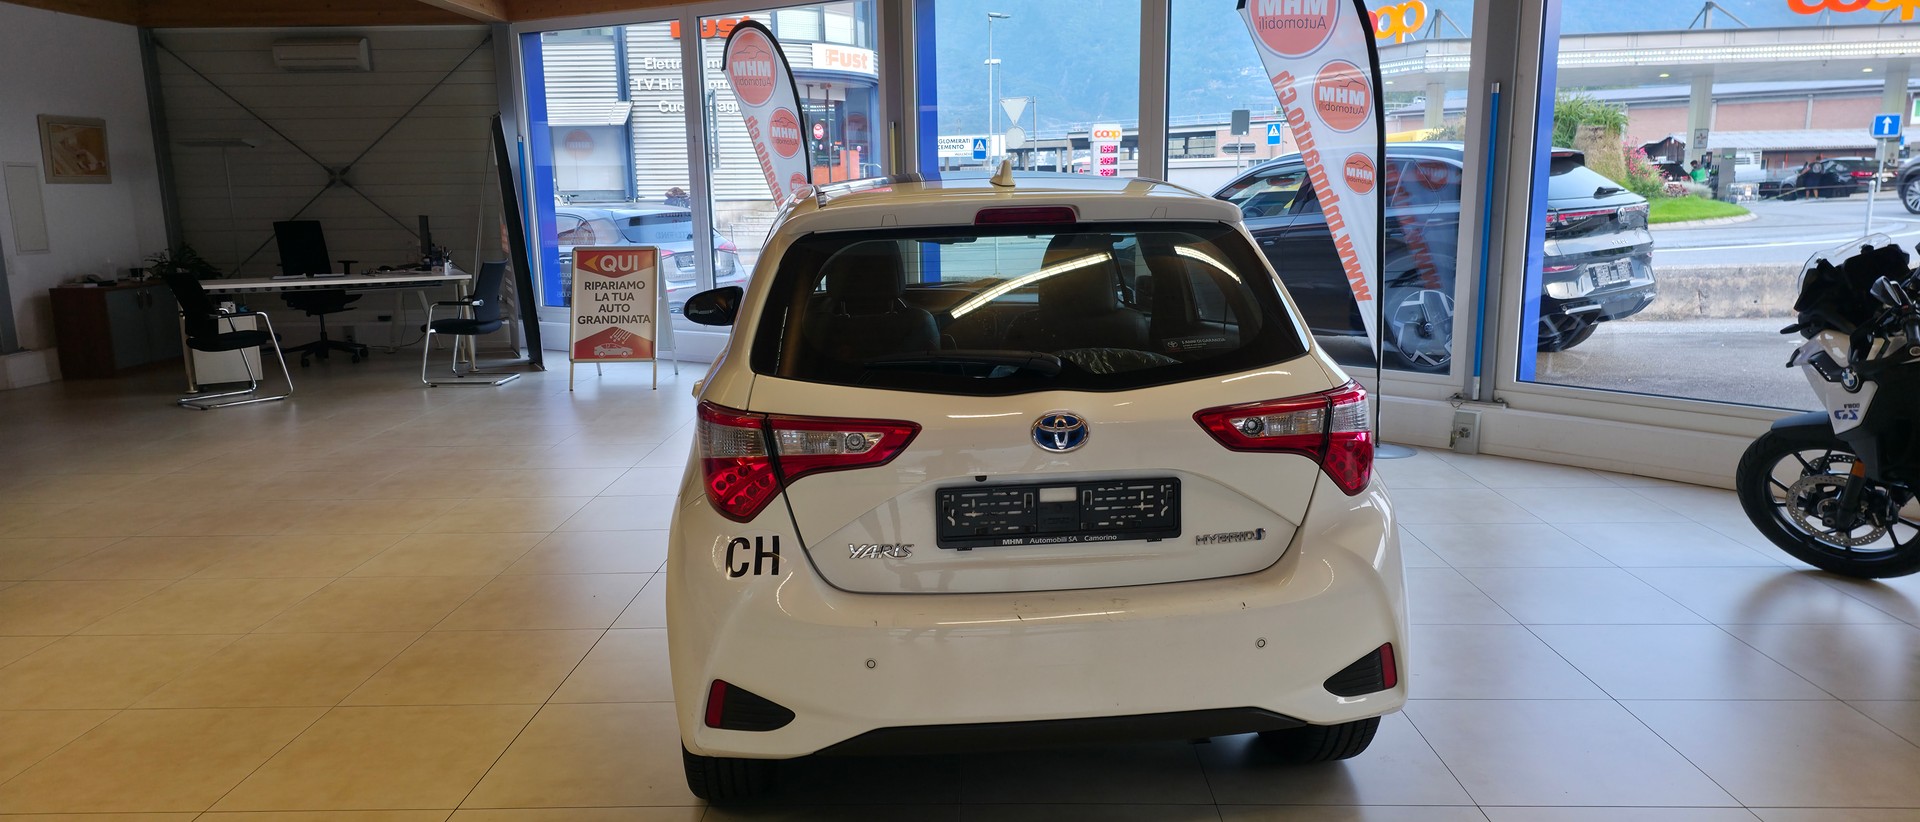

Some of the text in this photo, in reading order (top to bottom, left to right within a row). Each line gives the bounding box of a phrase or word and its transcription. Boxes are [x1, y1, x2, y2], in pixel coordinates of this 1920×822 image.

[1368, 0, 1427, 43] op
[828, 48, 868, 70] Fust
[634, 79, 654, 90] TV
[1094, 130, 1121, 140] coop
[600, 255, 638, 272] QUI
[584, 280, 645, 291] RIPARIAMO
[595, 292, 634, 302] LA TUA
[598, 303, 630, 313] AUTO
[577, 315, 651, 325] GRANDINATA
[1029, 536, 1067, 545] Automobili
[1084, 534, 1118, 542] Camorino
[1196, 531, 1255, 545] HYBRID
[725, 535, 780, 578] CH
[848, 544, 915, 559] YARIS
